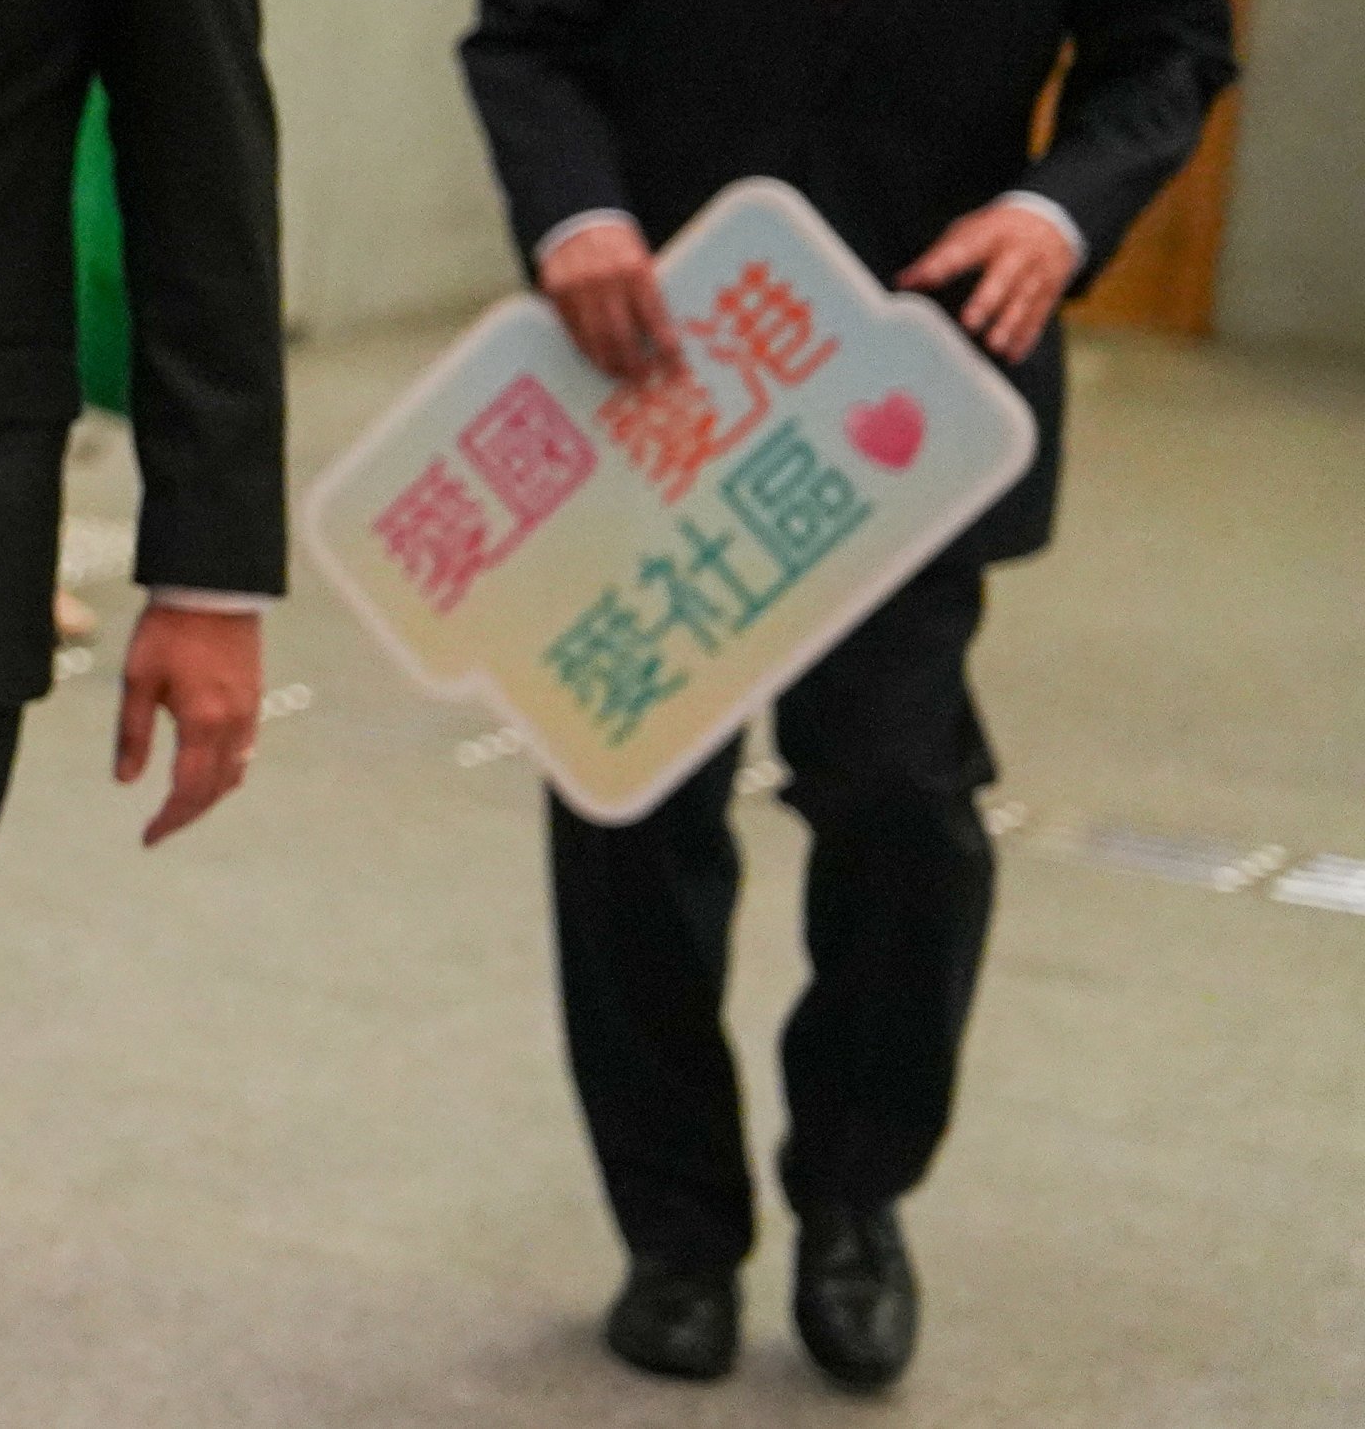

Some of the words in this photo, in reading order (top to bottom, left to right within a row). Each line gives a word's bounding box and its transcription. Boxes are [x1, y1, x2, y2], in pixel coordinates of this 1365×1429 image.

[370, 373, 598, 615] 愛國
[543, 419, 875, 745] 愛社區
